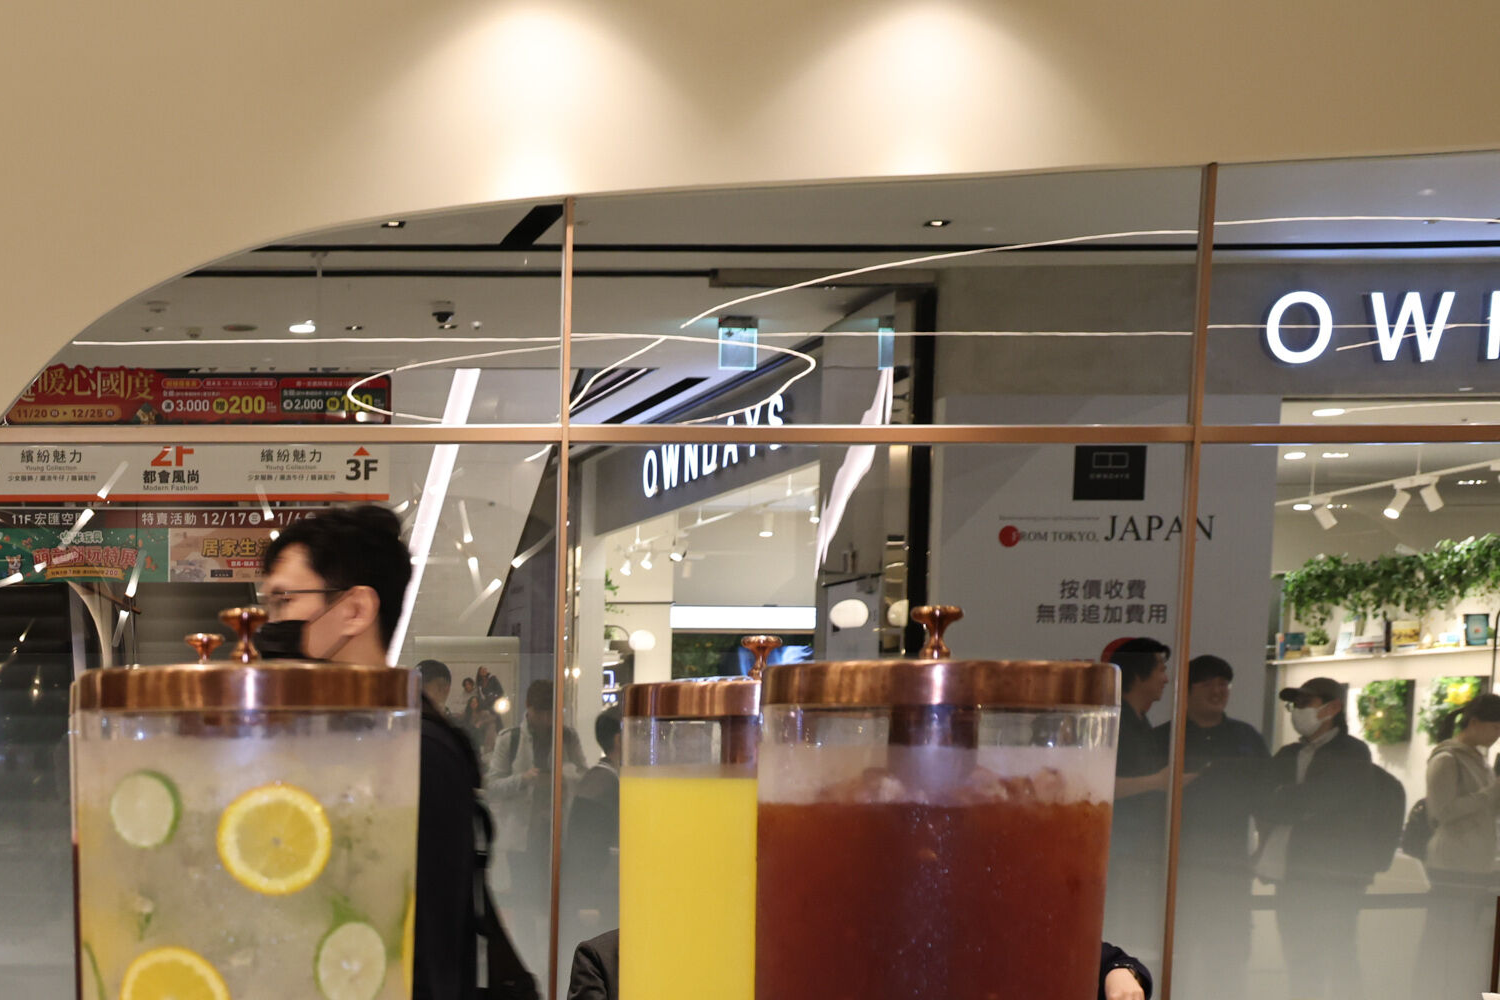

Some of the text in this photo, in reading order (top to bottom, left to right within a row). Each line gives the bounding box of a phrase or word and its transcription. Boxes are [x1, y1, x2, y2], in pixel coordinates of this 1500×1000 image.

[1266, 290, 1500, 364] OW
[228, 395, 266, 414] 200
[643, 394, 784, 498] OWNDAYS
[20, 449, 83, 464] 繽紛魅力
[260, 449, 322, 463] 繽紛魅力
[142, 470, 200, 484] 都會風尚
[345, 459, 379, 481] 3F
[142, 484, 199, 492] Modern Fashion
[11, 513, 32, 525] 11F
[141, 512, 197, 526] 特賣活動
[202, 512, 246, 526] 12/17
[1011, 530, 1048, 542] FROM
[1104, 515, 1216, 542] JAPAN
[1059, 579, 1147, 600] 按價收費
[1035, 603, 1168, 625] 無需追加費用
